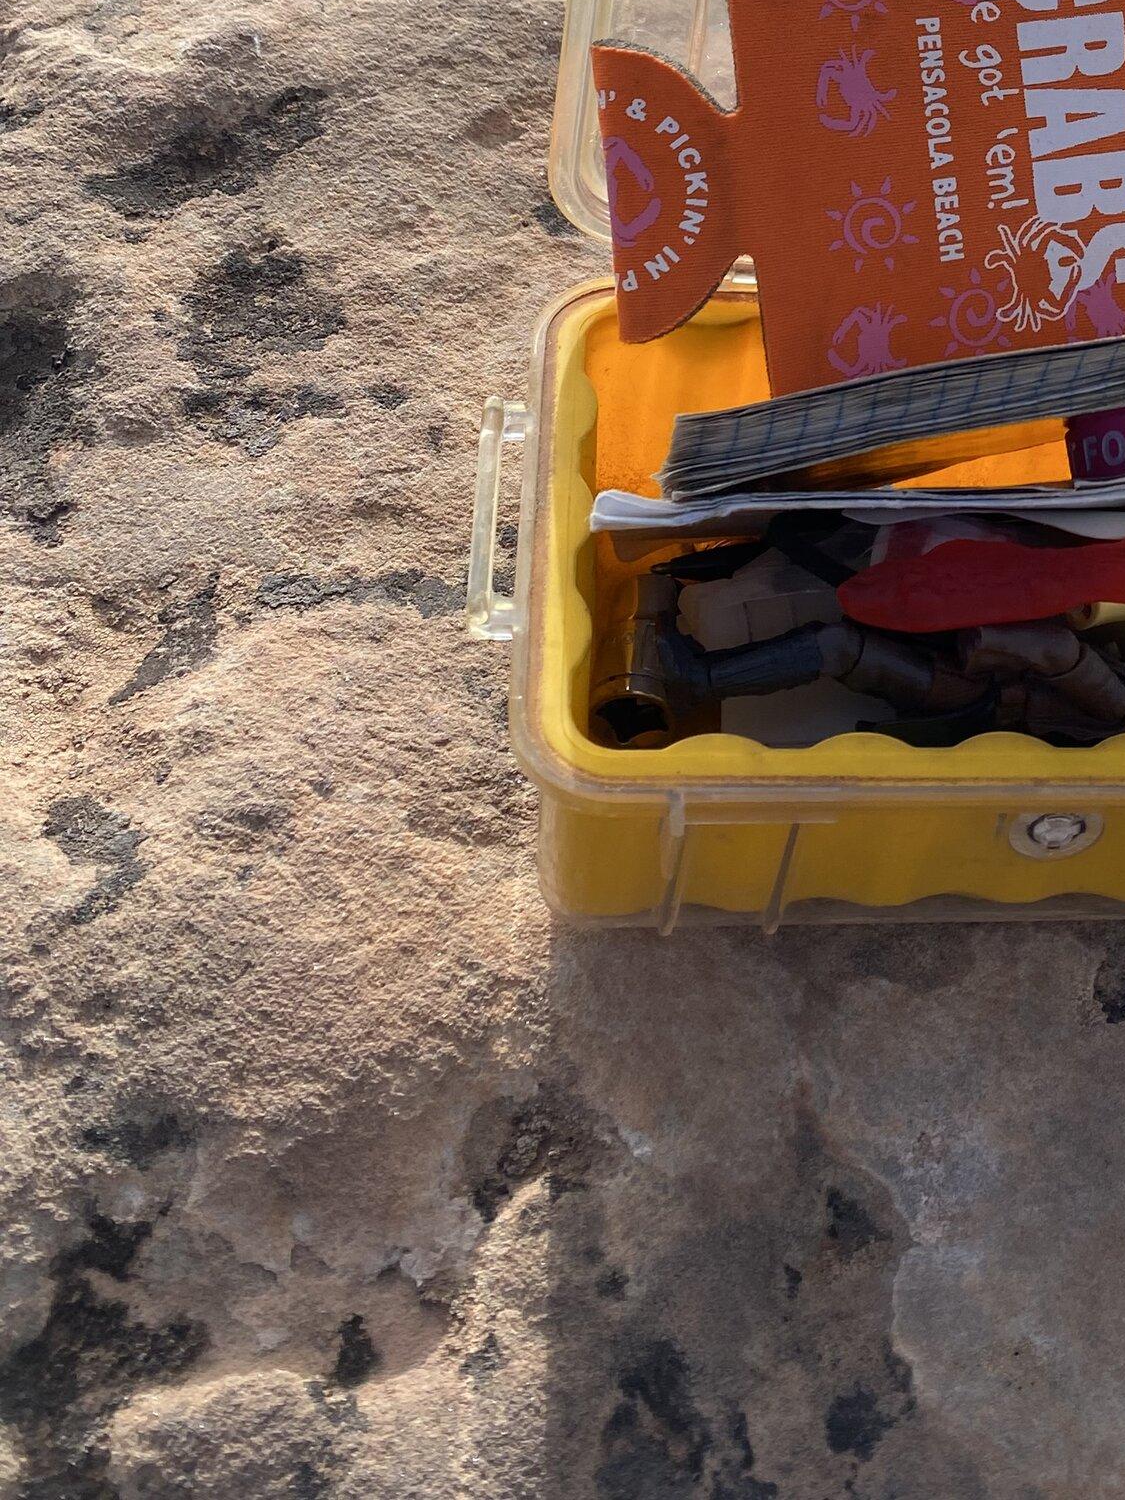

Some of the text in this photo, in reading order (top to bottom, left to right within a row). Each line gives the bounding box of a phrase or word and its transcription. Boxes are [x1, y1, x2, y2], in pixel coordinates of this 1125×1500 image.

[625, 98, 647, 122] &
[958, 44, 1020, 106] got
[915, 17, 965, 262] PENSACOLA BEACH
[984, 127, 1030, 210] 'em!
[654, 115, 709, 245] PICKIN'
[643, 245, 681, 280] IN
